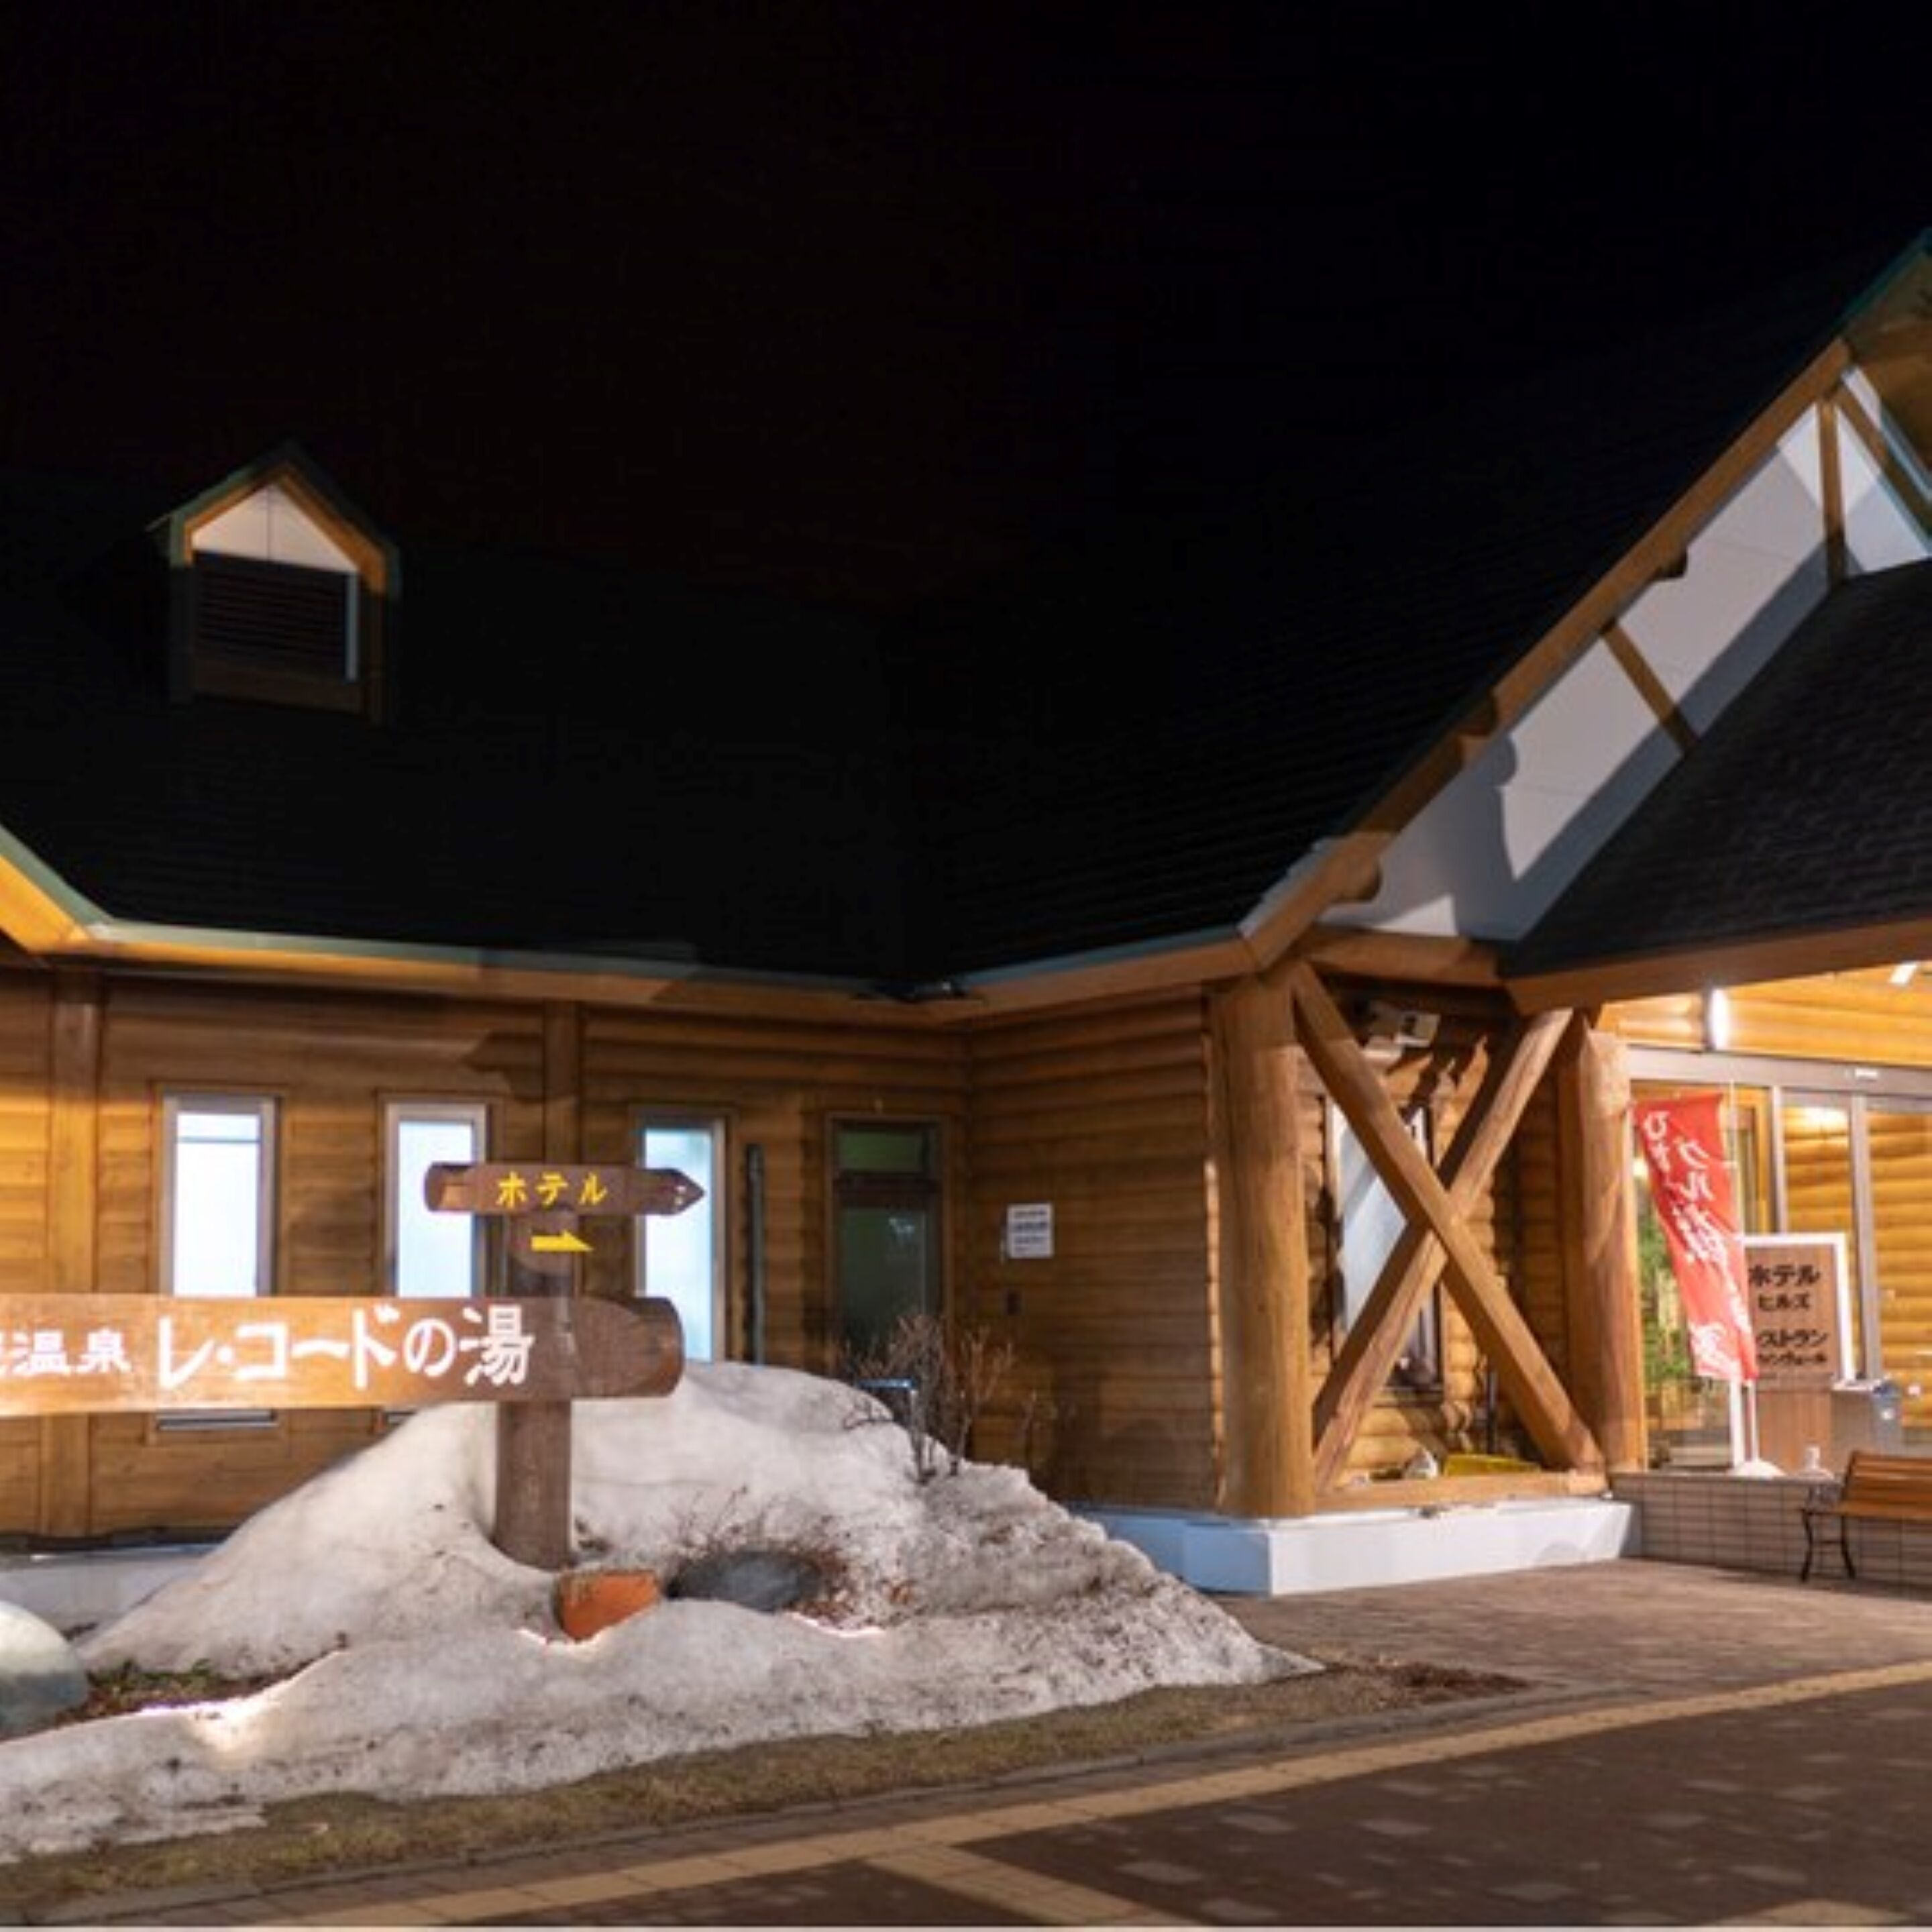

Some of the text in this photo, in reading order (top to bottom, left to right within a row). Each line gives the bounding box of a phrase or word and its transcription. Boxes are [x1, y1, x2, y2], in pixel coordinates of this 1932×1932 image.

[496, 1171, 608, 1206] ホテル
[1748, 1263, 1820, 1287] ホテル
[0, 1328, 133, 1377] 温泉
[1756, 1328, 1829, 1348] ストラン
